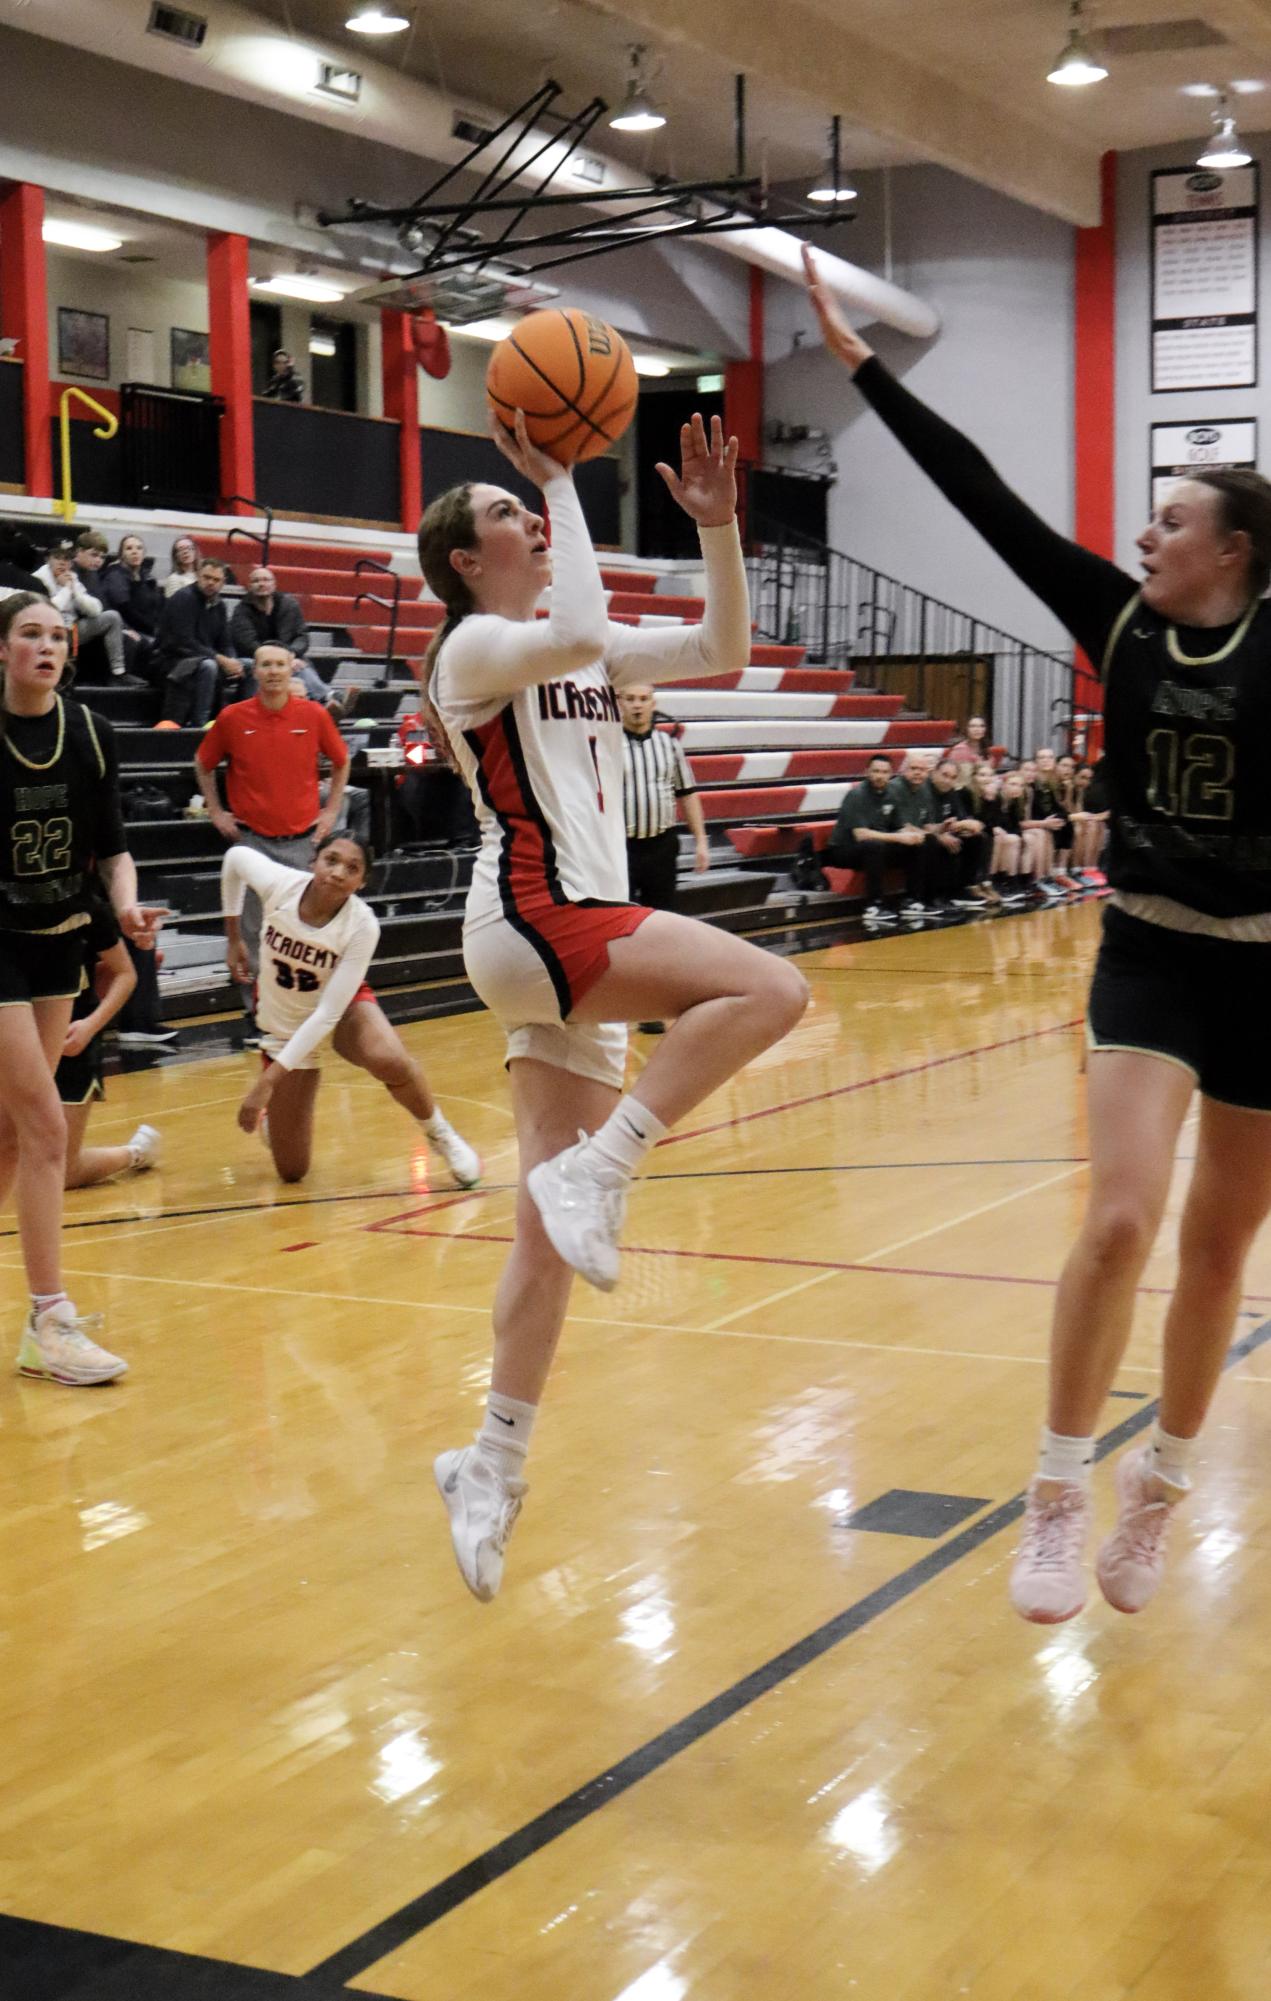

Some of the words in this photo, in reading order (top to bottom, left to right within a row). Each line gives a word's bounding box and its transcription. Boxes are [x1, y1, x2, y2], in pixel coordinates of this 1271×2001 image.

[1145, 728, 1237, 821] 12
[10, 816, 73, 876] 22
[265, 925, 341, 968] ACADEMY
